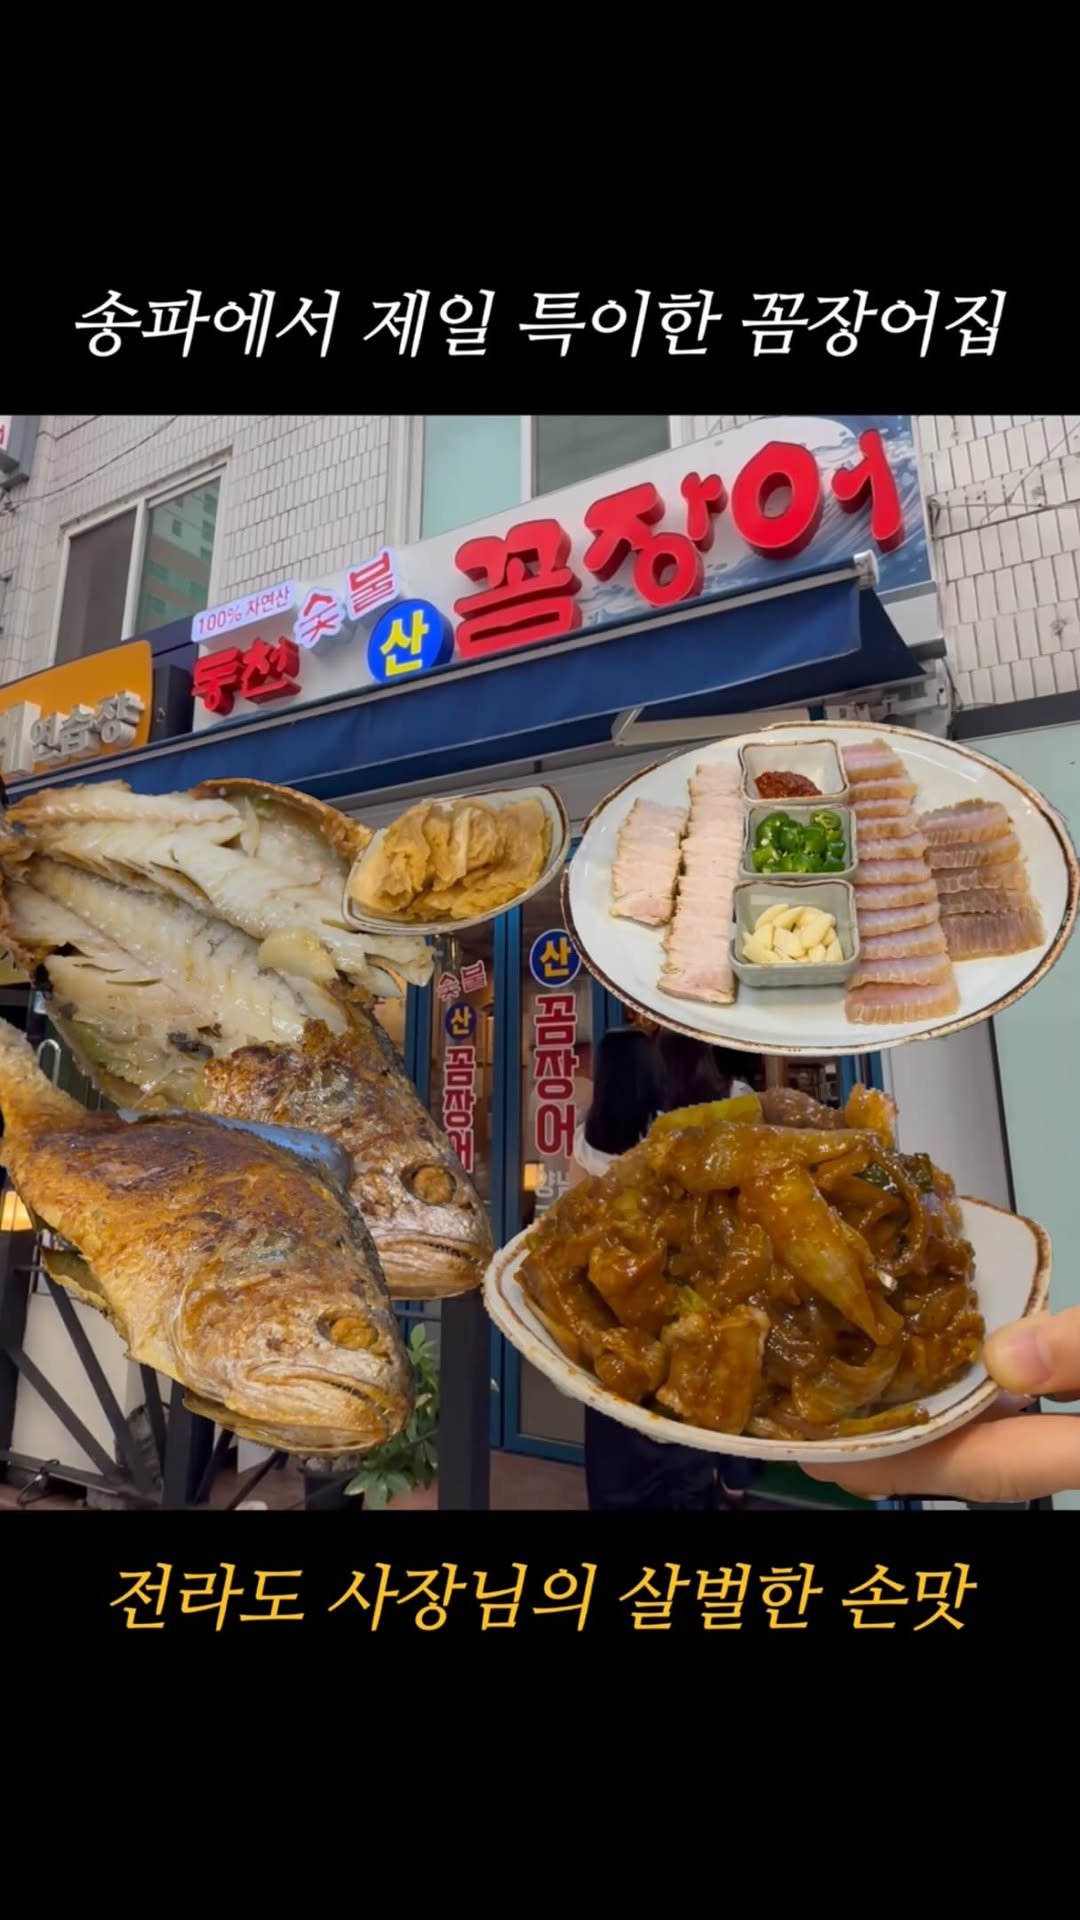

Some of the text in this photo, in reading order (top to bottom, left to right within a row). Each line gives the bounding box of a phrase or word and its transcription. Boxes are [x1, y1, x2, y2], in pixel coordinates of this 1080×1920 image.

[192, 428, 906, 716] 동천 숯불 산 꼼장어
[198, 586, 291, 635] 100% 자연산
[540, 936, 571, 978] 산
[450, 1006, 472, 1035] 산
[533, 993, 579, 1158] 꼼장어
